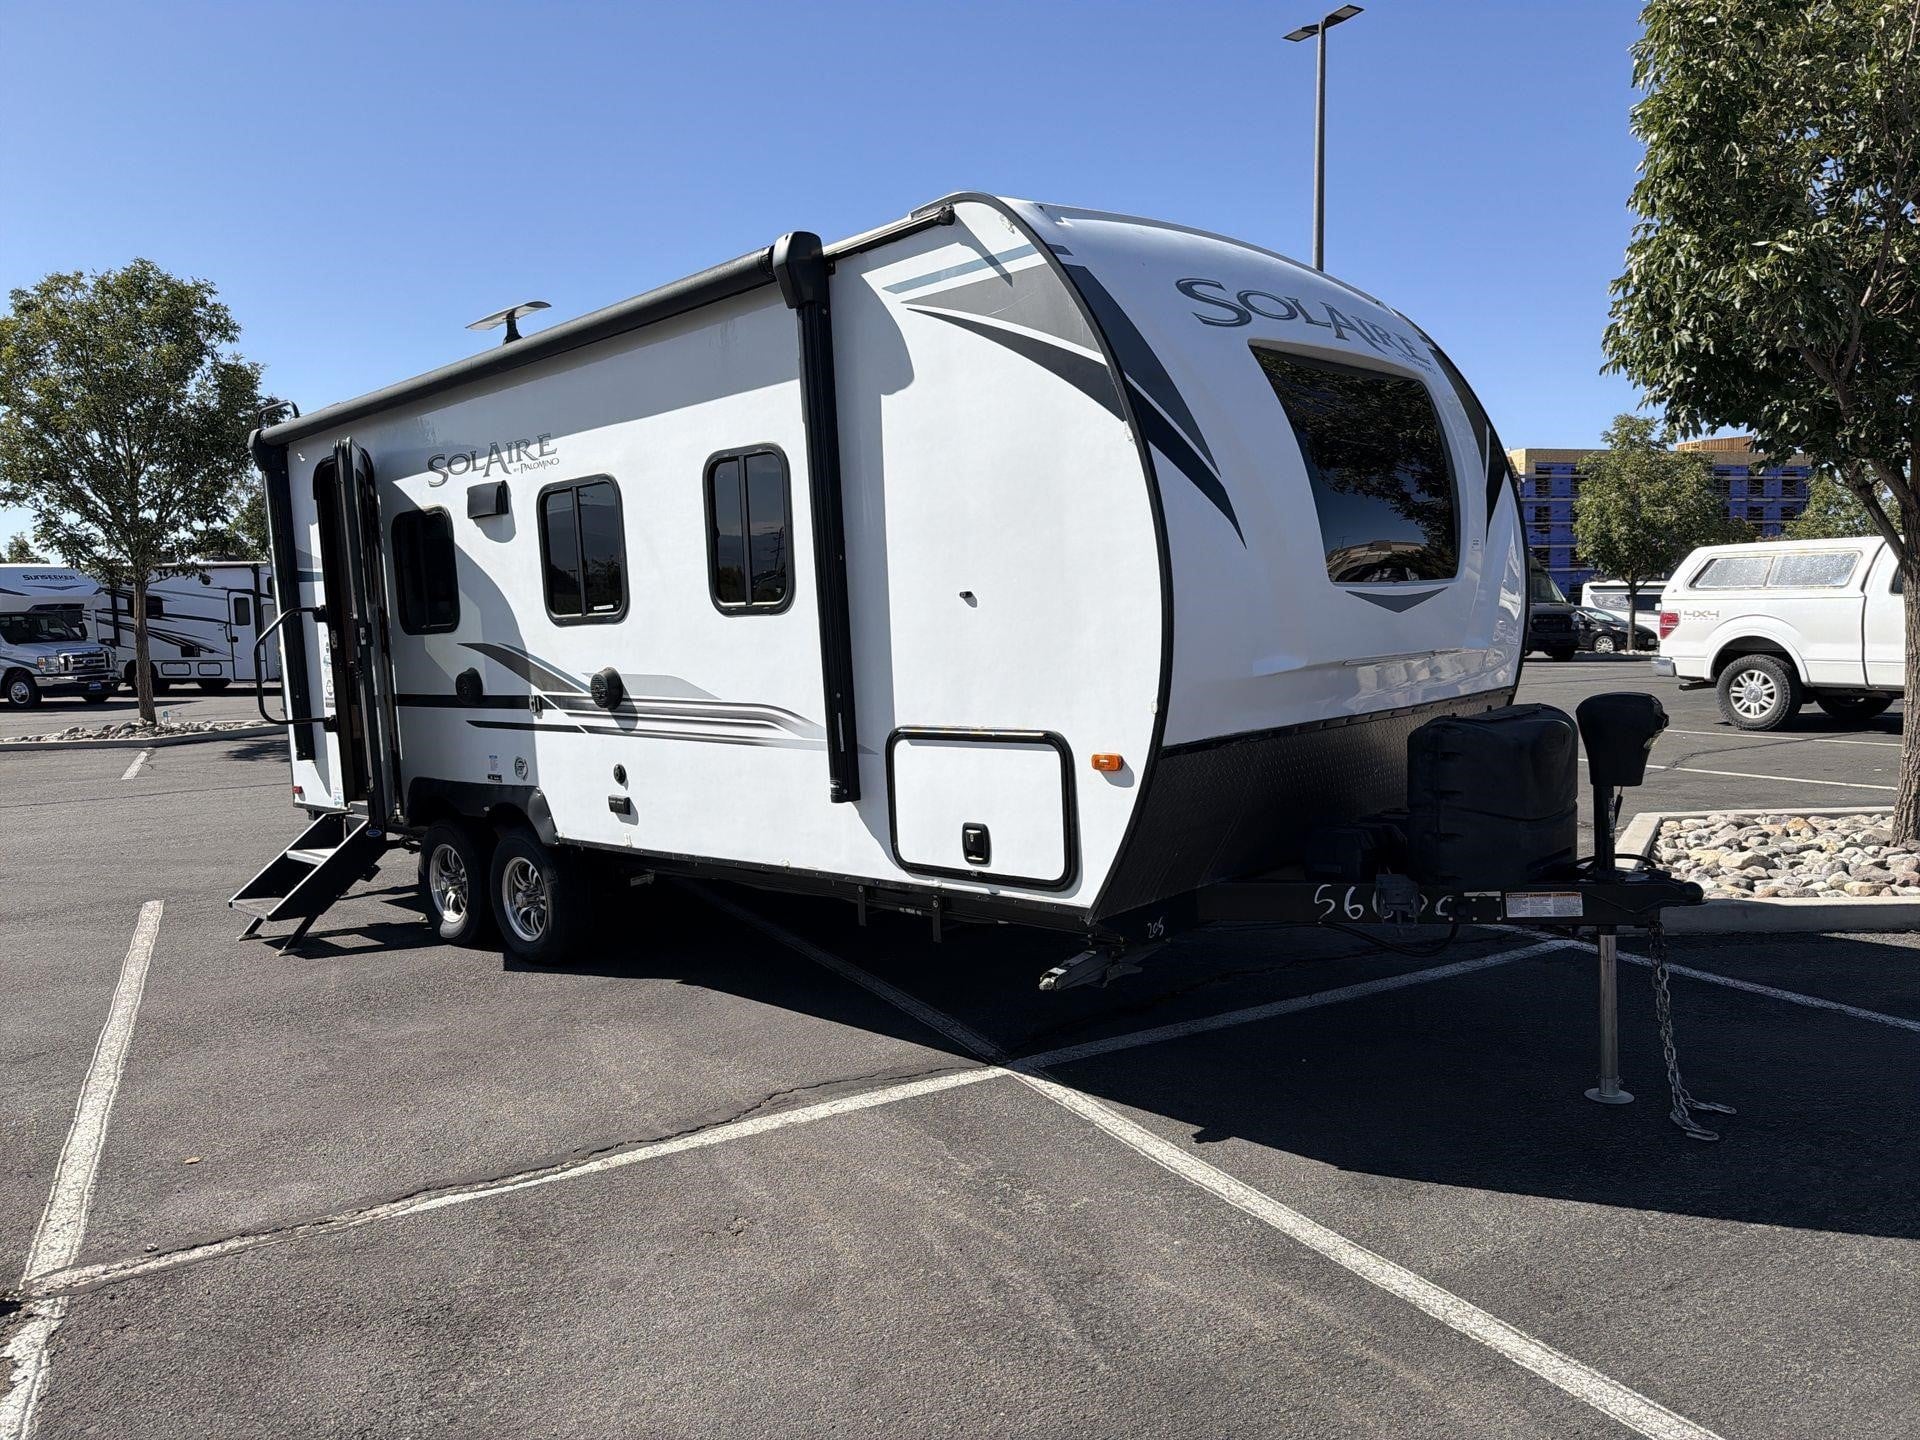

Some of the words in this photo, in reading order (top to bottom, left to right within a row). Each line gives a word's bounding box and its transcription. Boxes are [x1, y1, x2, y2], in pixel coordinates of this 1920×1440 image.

[1175, 278, 1431, 366] SOLAIRE
[427, 433, 558, 488] SOLAIRE
[520, 457, 560, 474] PALOMINO
